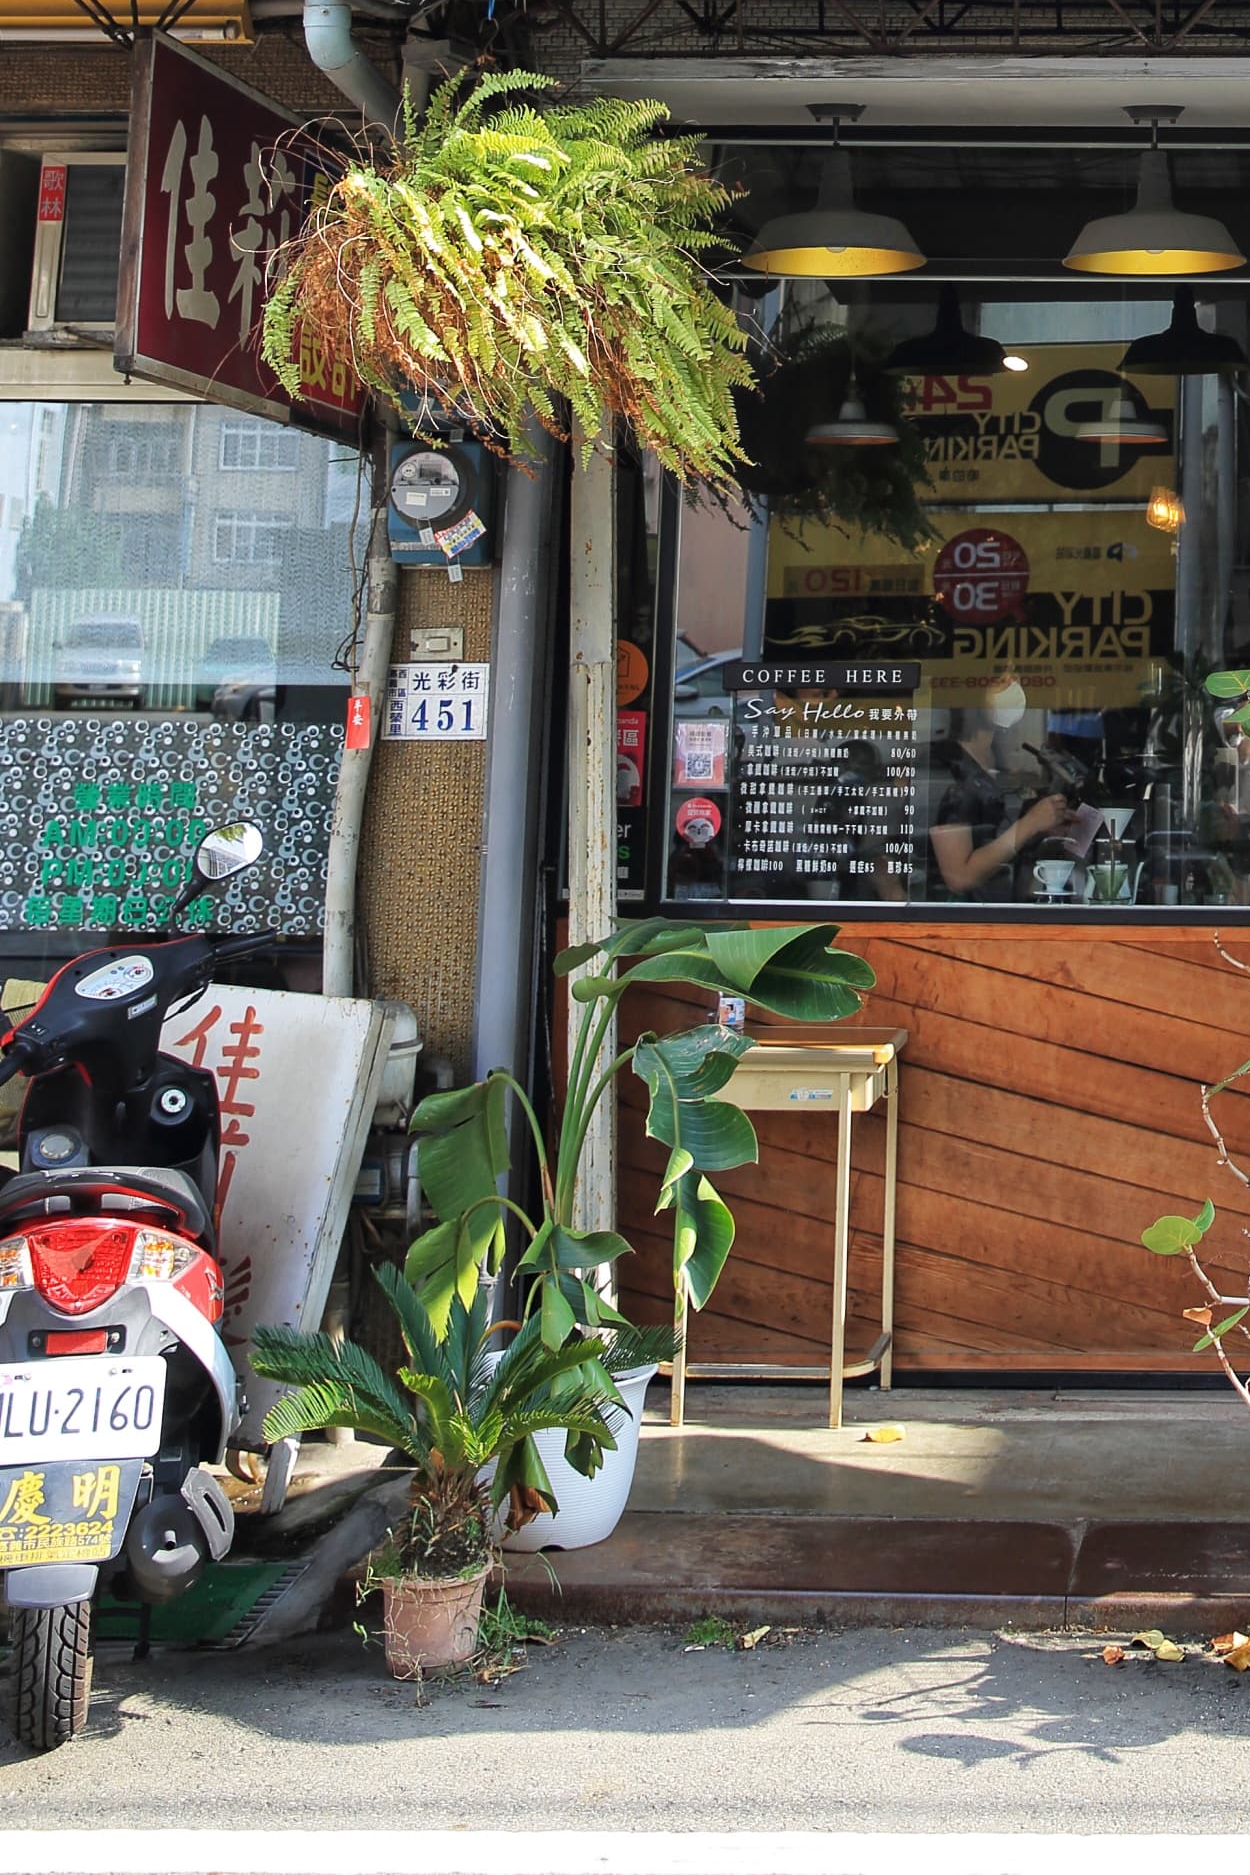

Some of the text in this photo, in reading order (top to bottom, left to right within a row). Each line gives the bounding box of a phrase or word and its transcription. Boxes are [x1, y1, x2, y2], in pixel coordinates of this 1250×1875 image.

[412, 671, 480, 691] 光彩街
[742, 669, 902, 683] COFFEE HERE
[411, 699, 475, 731] 451
[743, 698, 918, 723] Say Hello 我要外帶
[890, 747, 917, 760] 80/60
[886, 766, 916, 779] 100/80
[904, 805, 915, 816] 90
[885, 842, 914, 856] 100/80
